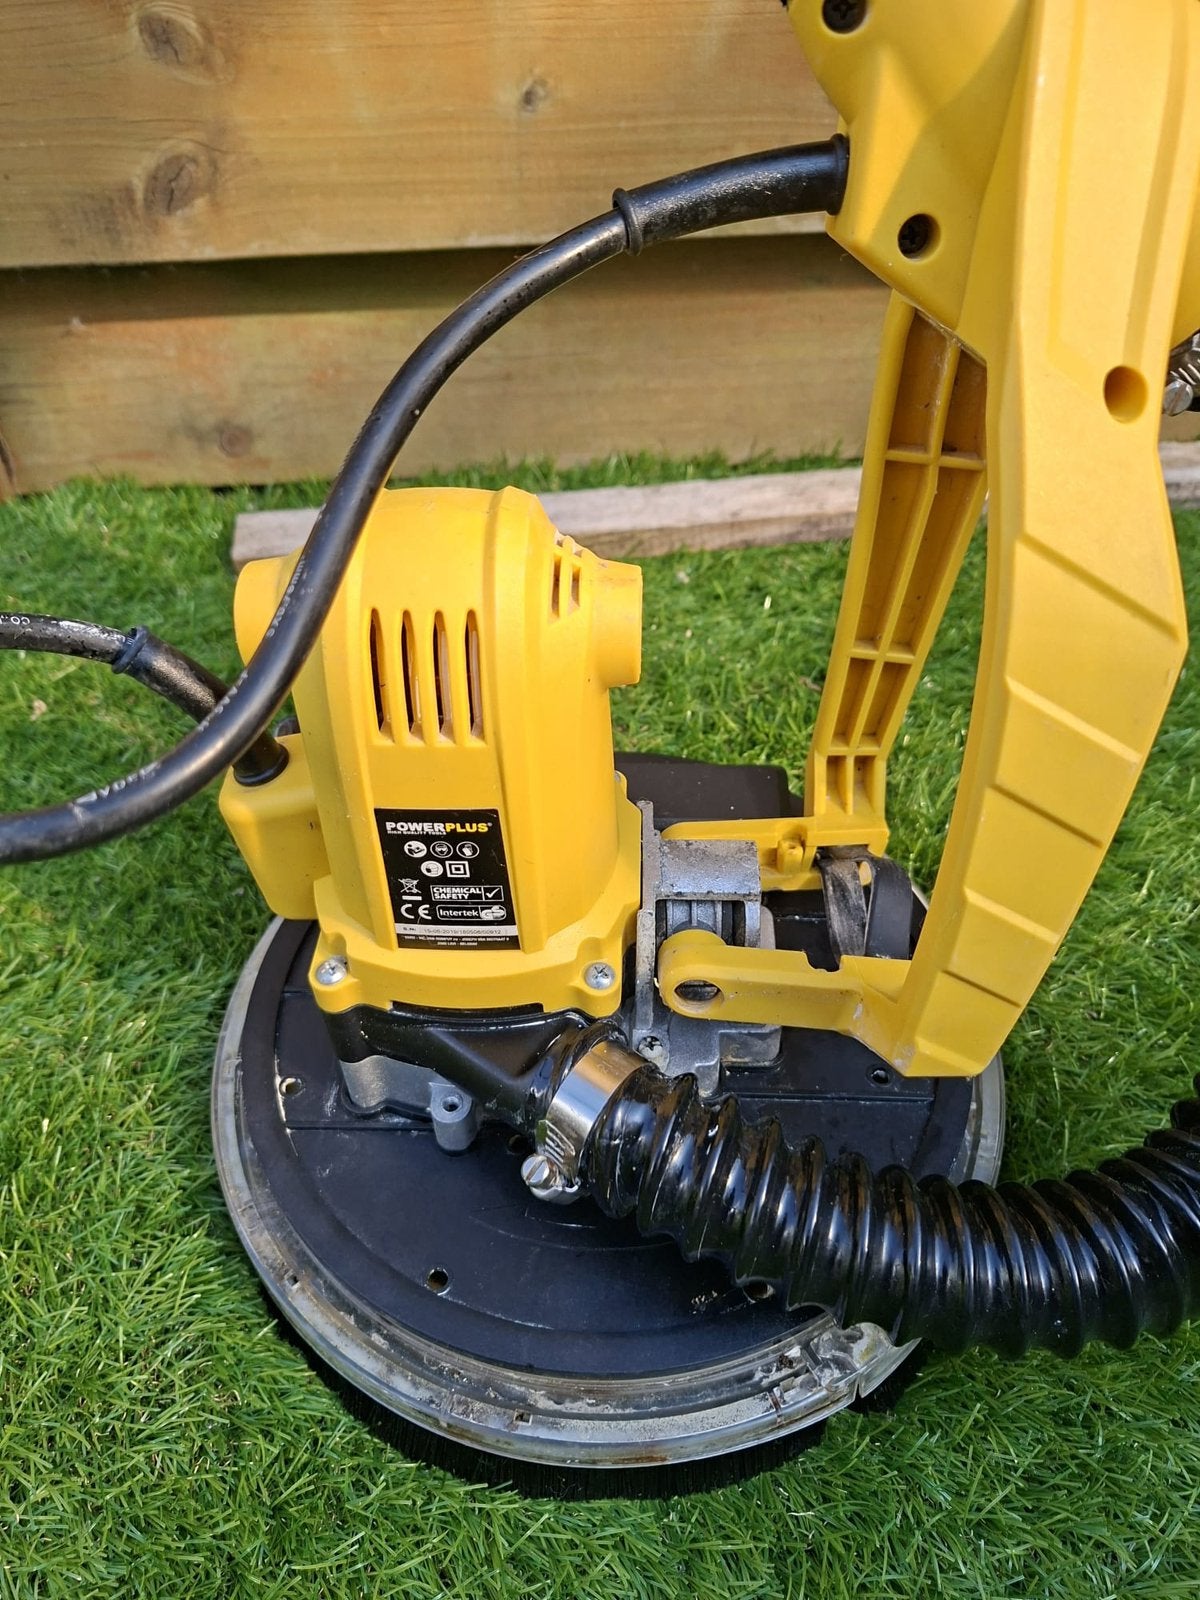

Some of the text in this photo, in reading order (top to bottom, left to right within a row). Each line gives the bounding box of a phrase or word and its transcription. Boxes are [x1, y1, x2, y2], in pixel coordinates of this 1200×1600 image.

[385, 821, 488, 833] POWERPLUS
[400, 903, 432, 920] CE
[439, 908, 479, 917] Intertek
